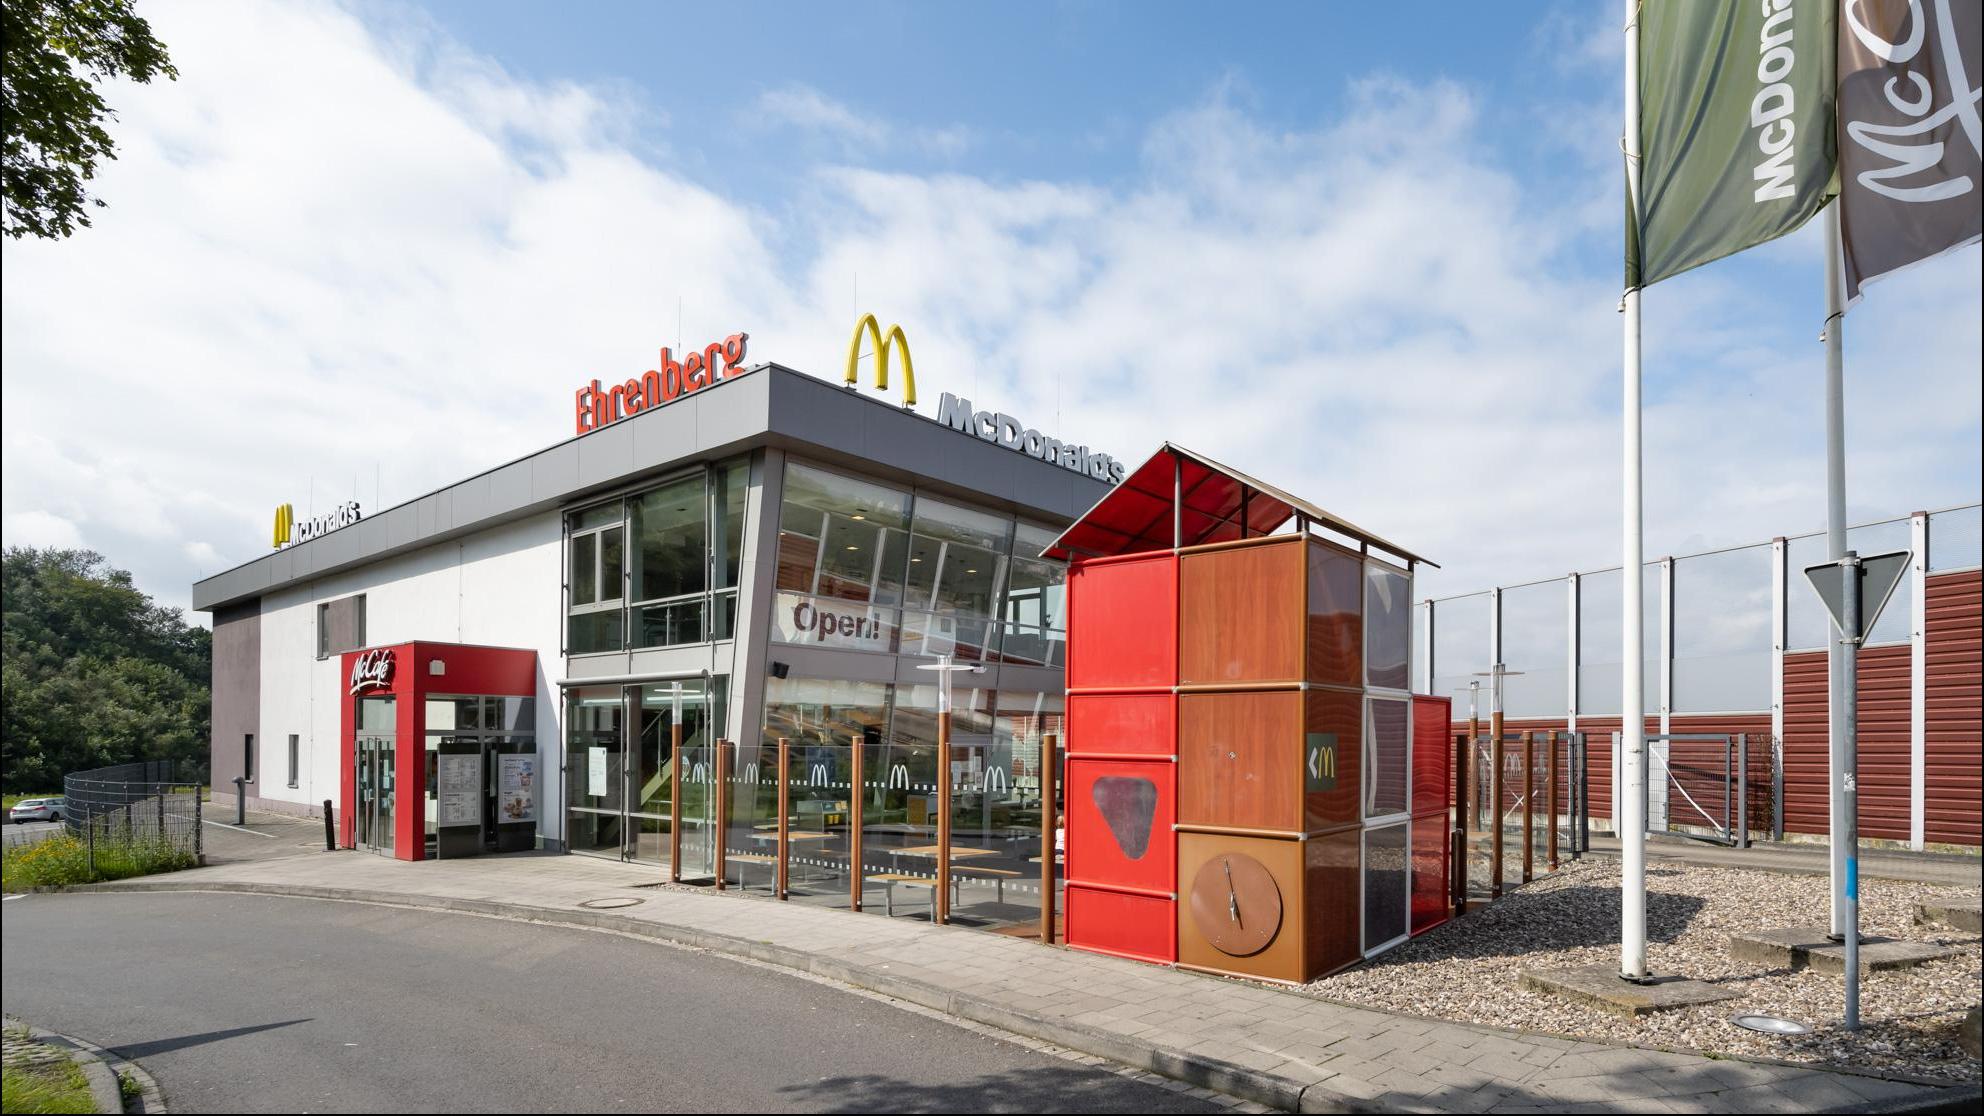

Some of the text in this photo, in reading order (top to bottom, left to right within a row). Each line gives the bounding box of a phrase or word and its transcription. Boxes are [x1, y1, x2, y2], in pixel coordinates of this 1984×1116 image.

[575, 332, 749, 436] Ehrenberg
[937, 391, 1125, 485] McDonald's
[290, 501, 361, 547] McDonald's
[793, 602, 880, 641] Open!
[350, 649, 391, 691] McCafé
